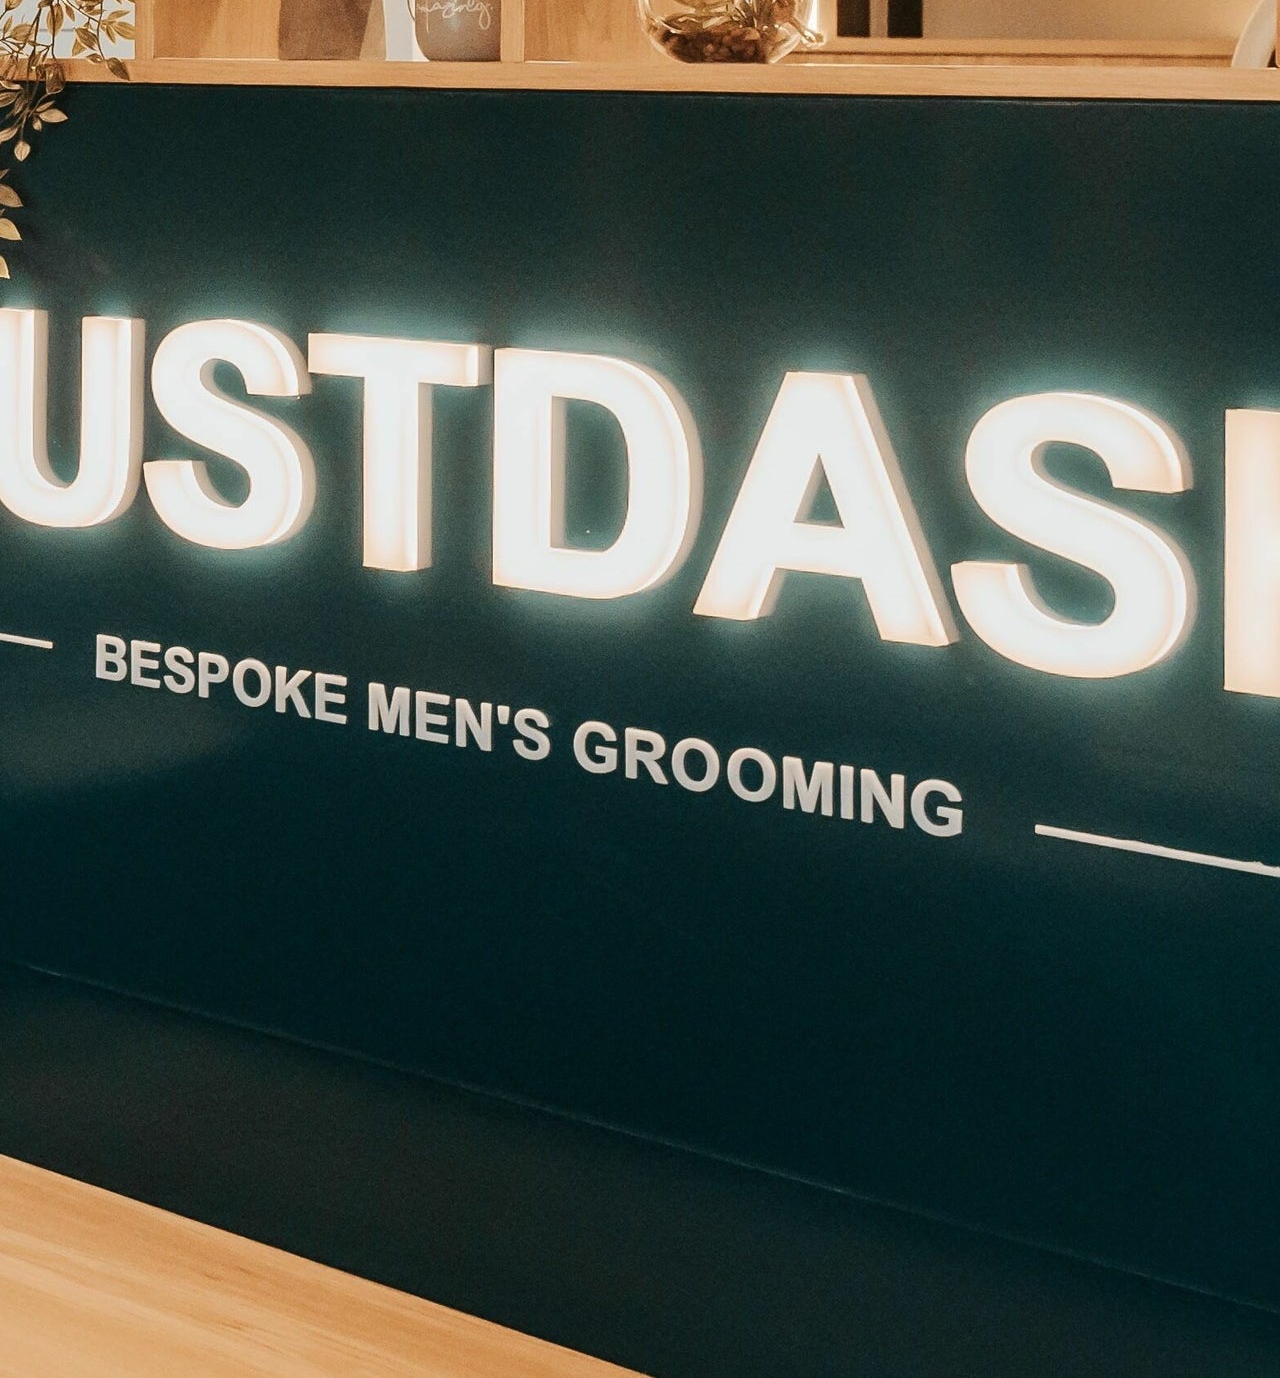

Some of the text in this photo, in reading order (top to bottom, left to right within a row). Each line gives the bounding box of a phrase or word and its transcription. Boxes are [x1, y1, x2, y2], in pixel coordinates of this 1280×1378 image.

[95, 633, 964, 838] BESPOKE MEN'S GROOMING
